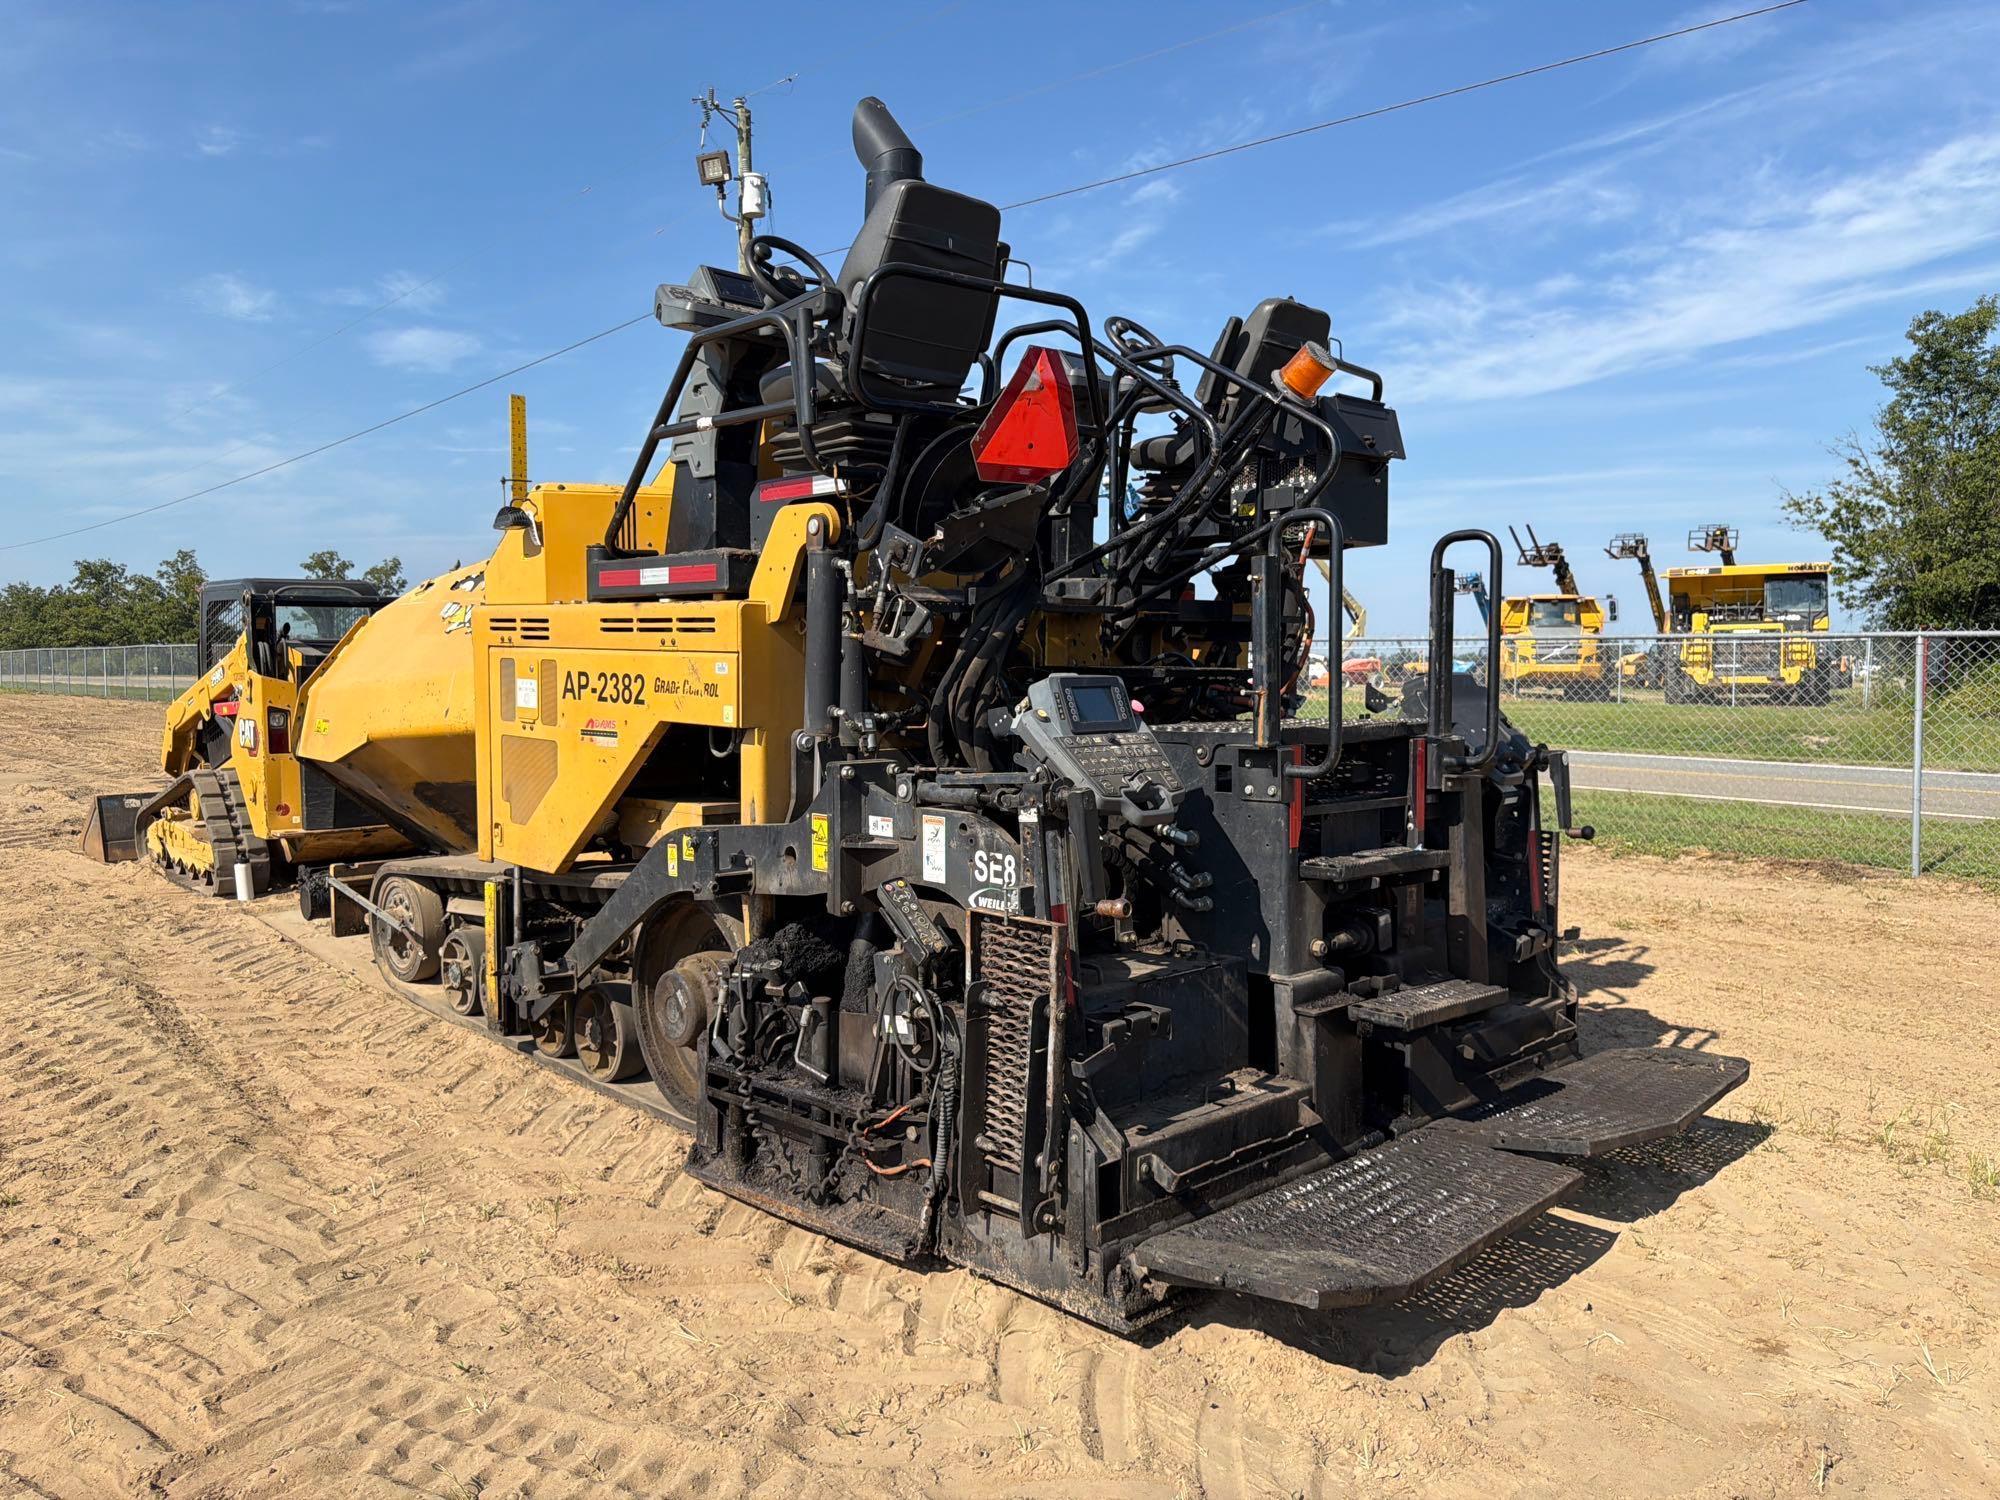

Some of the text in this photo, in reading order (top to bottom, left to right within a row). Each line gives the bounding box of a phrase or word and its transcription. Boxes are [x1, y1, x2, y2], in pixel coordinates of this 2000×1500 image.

[562, 670, 646, 706] AP-2382
[239, 719, 255, 749] CAT
[585, 718, 617, 729] ADAMS
[974, 849, 1017, 888] SE8
[978, 896, 1018, 914] WEIL
